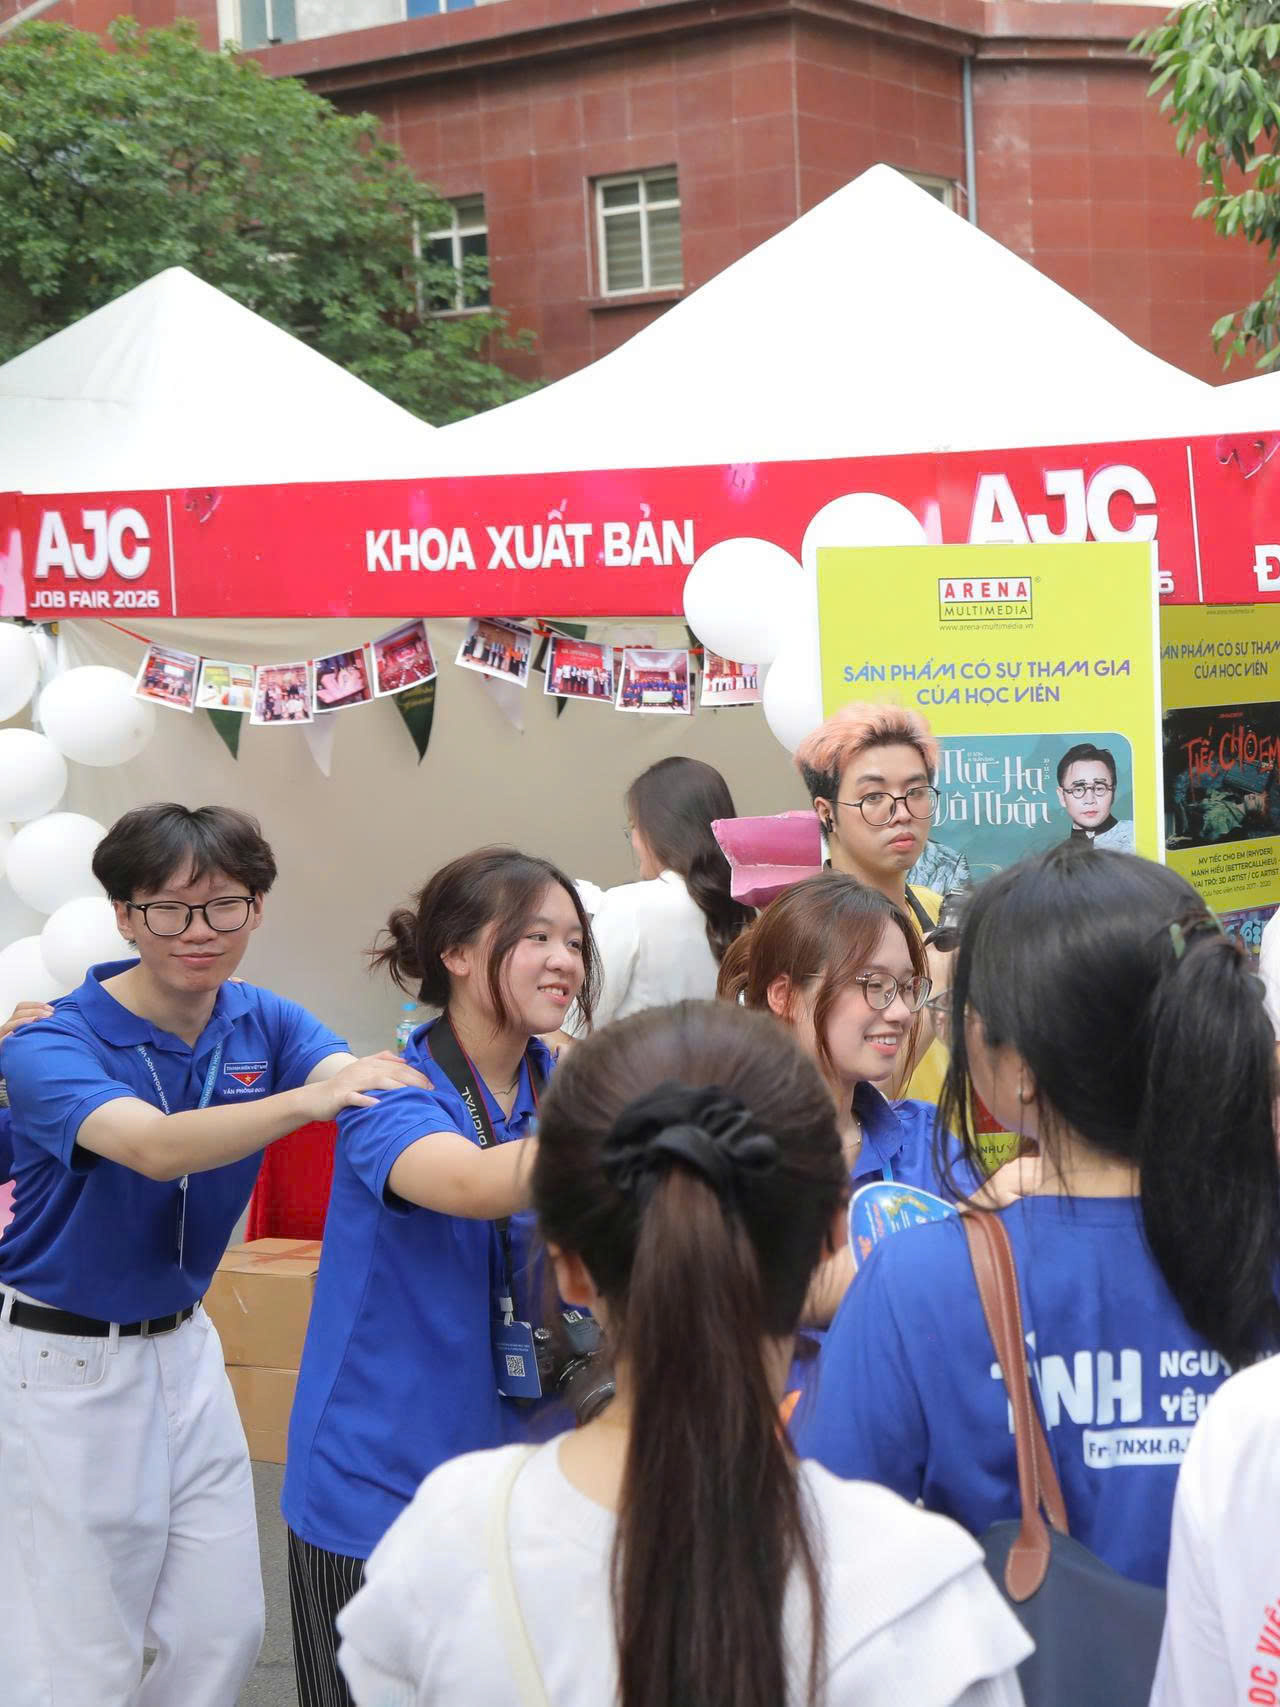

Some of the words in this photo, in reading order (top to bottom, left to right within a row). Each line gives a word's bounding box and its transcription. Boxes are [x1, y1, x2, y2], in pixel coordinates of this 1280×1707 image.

[969, 465, 1158, 544] AJC
[33, 508, 151, 580] AJC
[365, 527, 471, 572] KHOA
[486, 498, 592, 569] XUẤT
[602, 502, 696, 567] BẢN
[30, 591, 66, 608] JOB
[69, 591, 112, 608] FAIR
[114, 590, 160, 608] 2026
[944, 582, 1028, 598] ARENA
[944, 605, 1028, 616] MULTIMEDIA
[843, 661, 886, 682] SẢN
[960, 659, 991, 680] CÓ
[996, 662, 1022, 681] SỰ
[1027, 661, 1090, 679] THAM
[1094, 659, 1131, 677] GIA
[916, 684, 960, 705] CỦA
[965, 686, 1009, 706] HỌC
[1236, 851, 1246, 860] EM
[1228, 873, 1247, 883] ARTIST
[1260, 868, 1280, 878] ARTIST
[202, 1090, 210, 1109] HÒNG
[462, 1086, 487, 1145] DIGITAL
